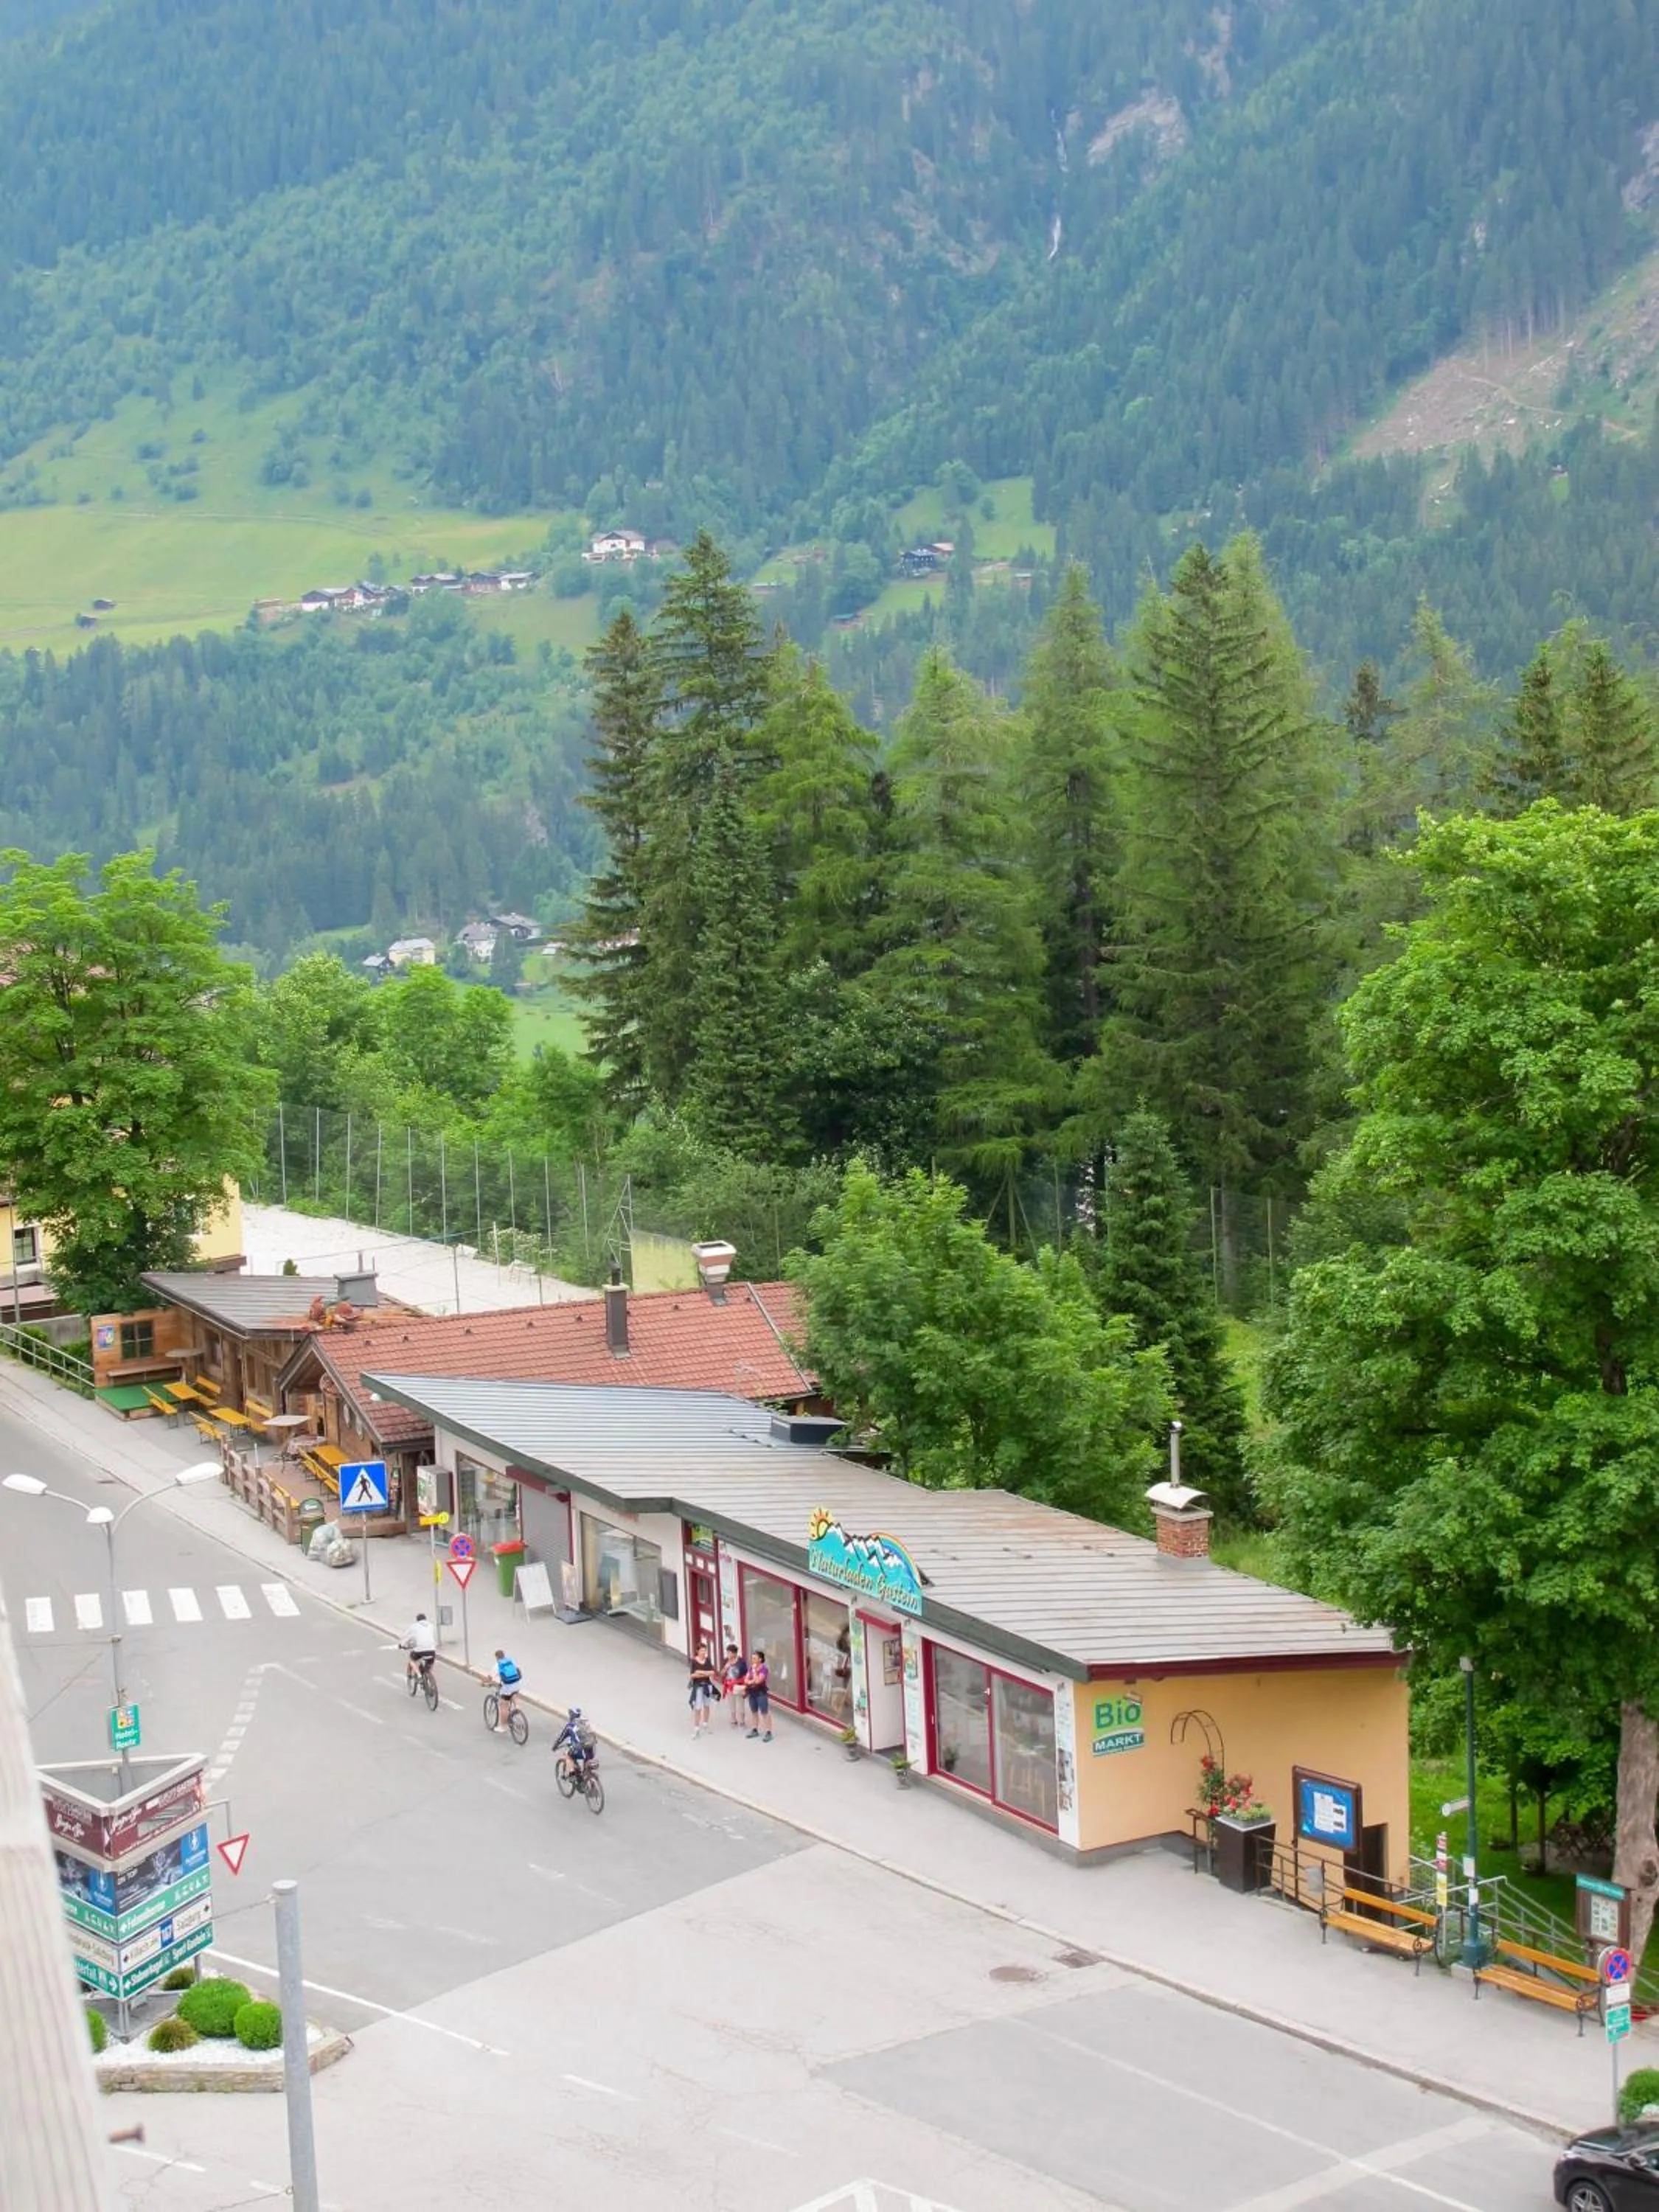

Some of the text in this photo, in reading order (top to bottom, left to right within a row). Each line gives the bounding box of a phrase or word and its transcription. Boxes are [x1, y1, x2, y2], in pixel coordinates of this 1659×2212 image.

[812, 1549, 918, 1610] Naturladen Gastein
[1096, 1700, 1141, 1729] Bio
[1095, 1734, 1141, 1751] MARKT
